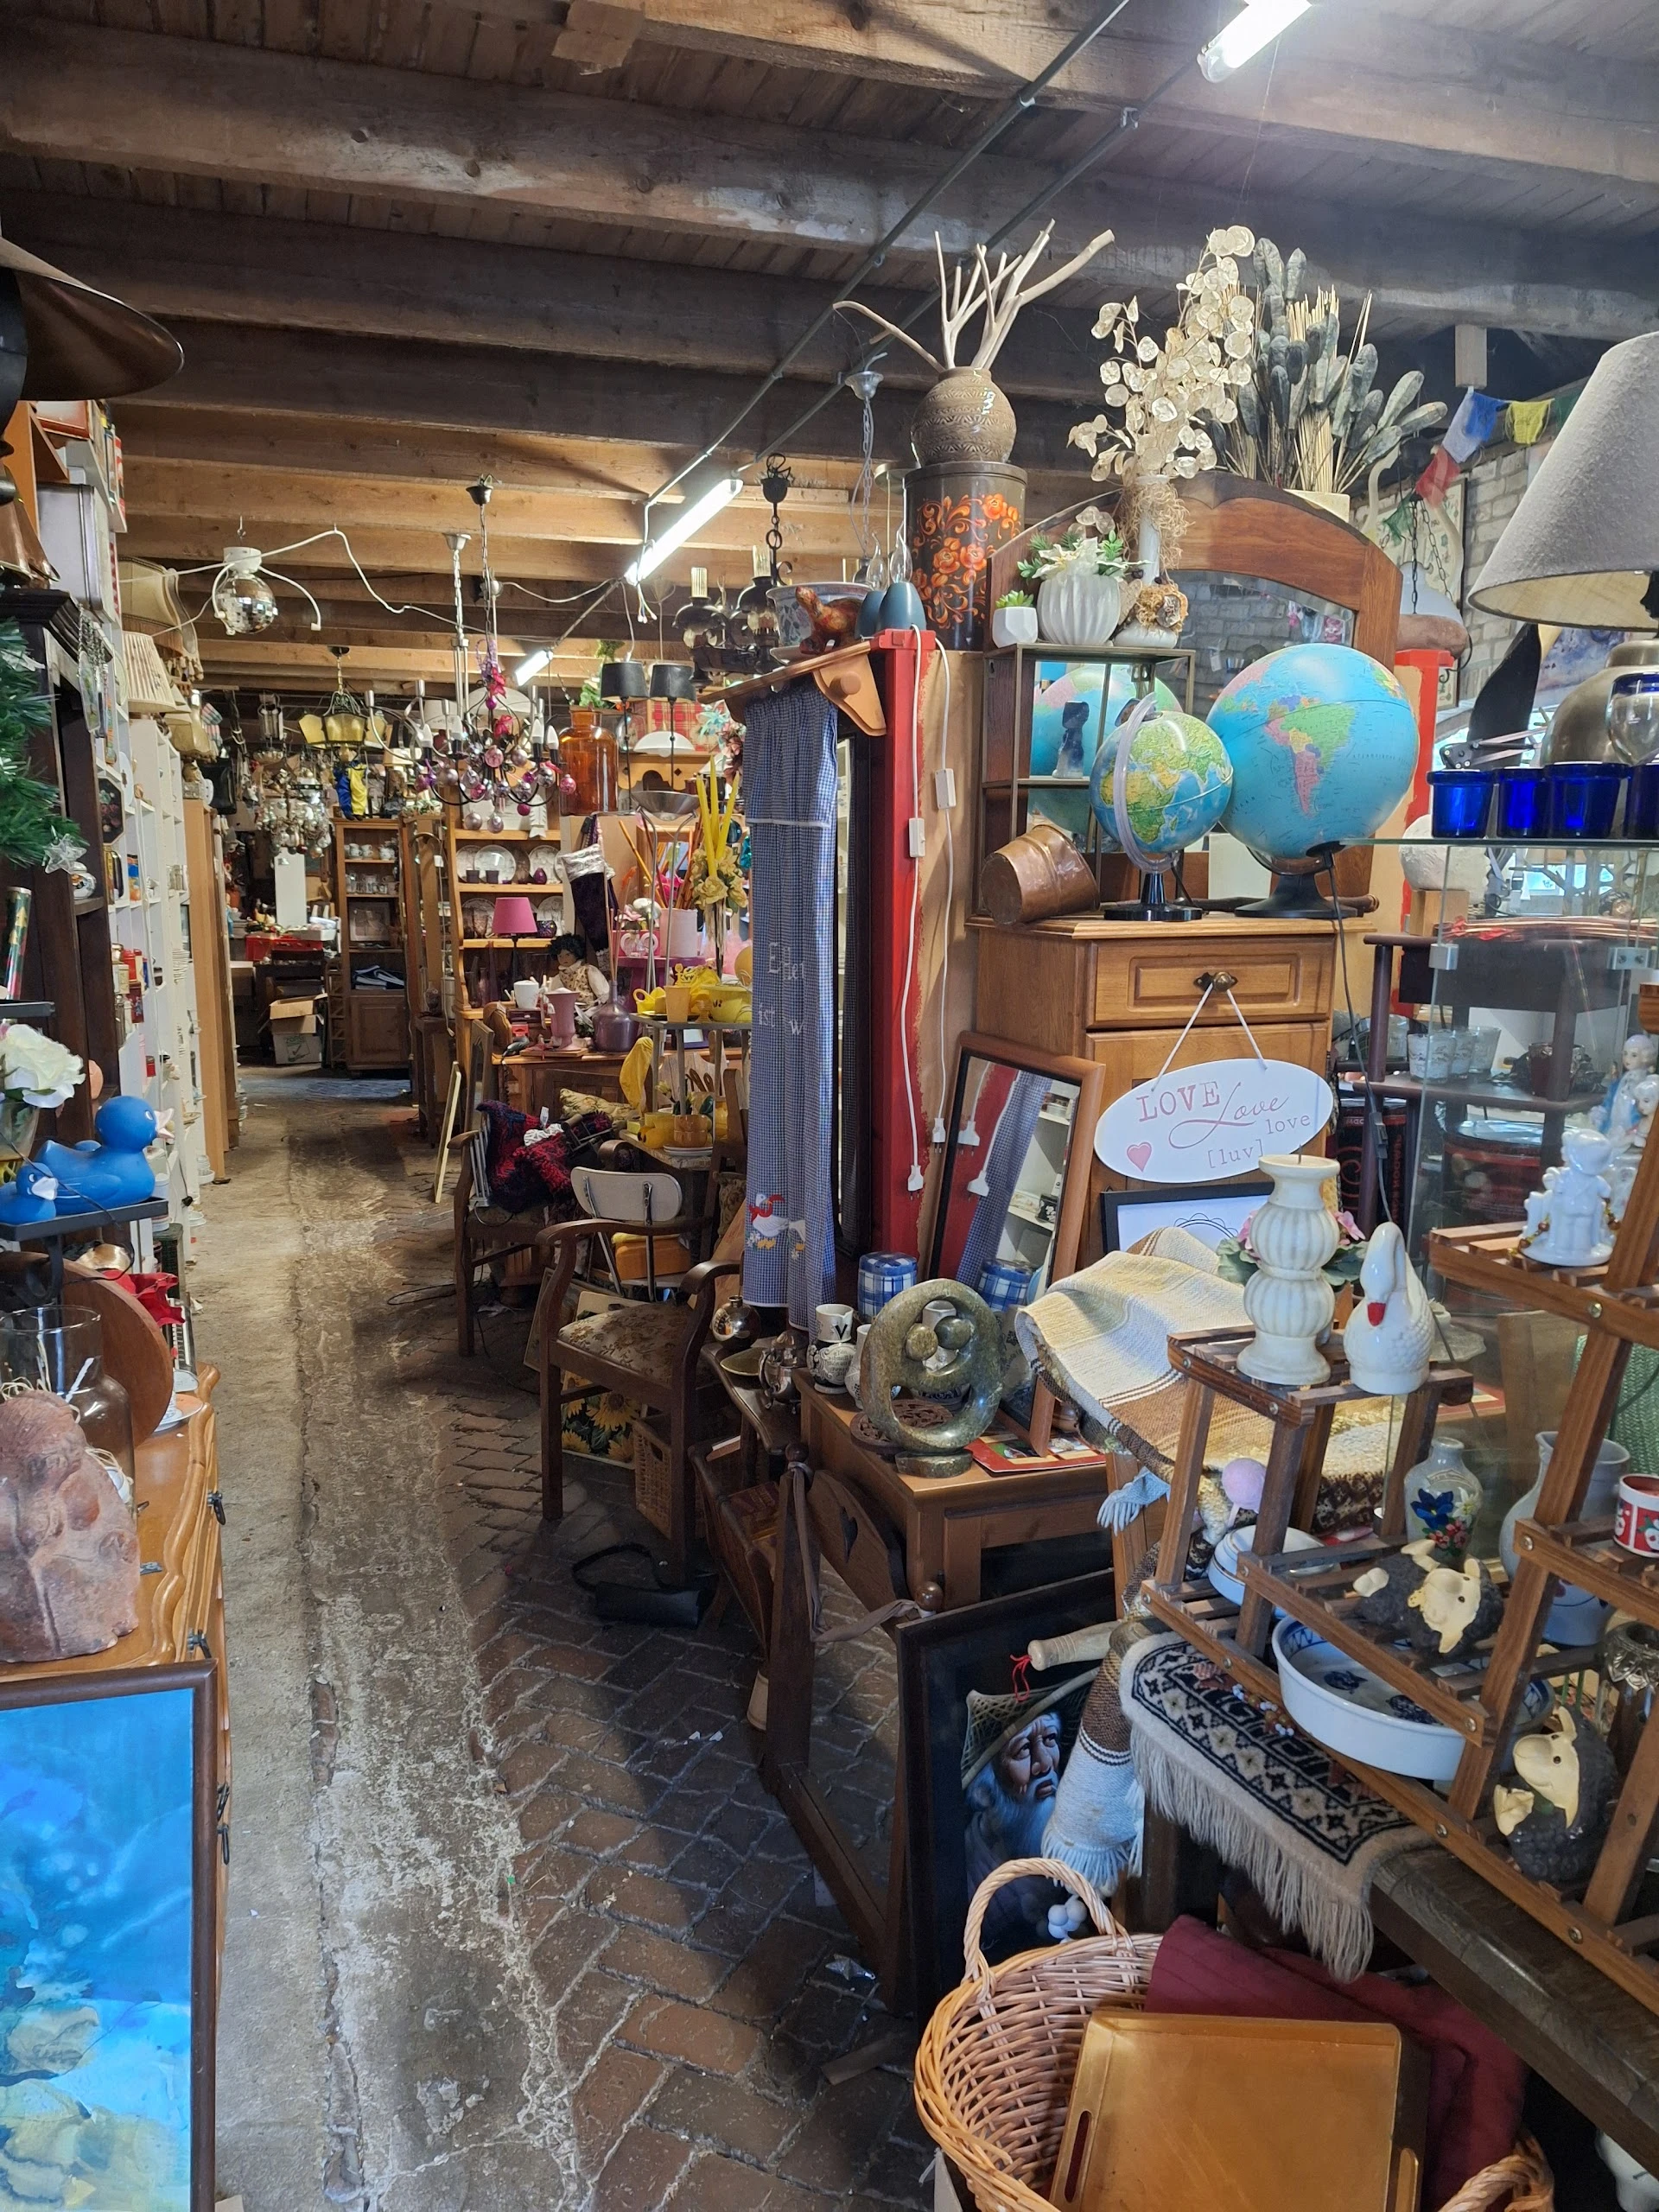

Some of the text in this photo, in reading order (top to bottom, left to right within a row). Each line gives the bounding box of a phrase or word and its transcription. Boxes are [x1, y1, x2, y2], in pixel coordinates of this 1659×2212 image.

[1136, 1081, 1290, 1149] LOVE Love
[1267, 1114, 1311, 1135] love
